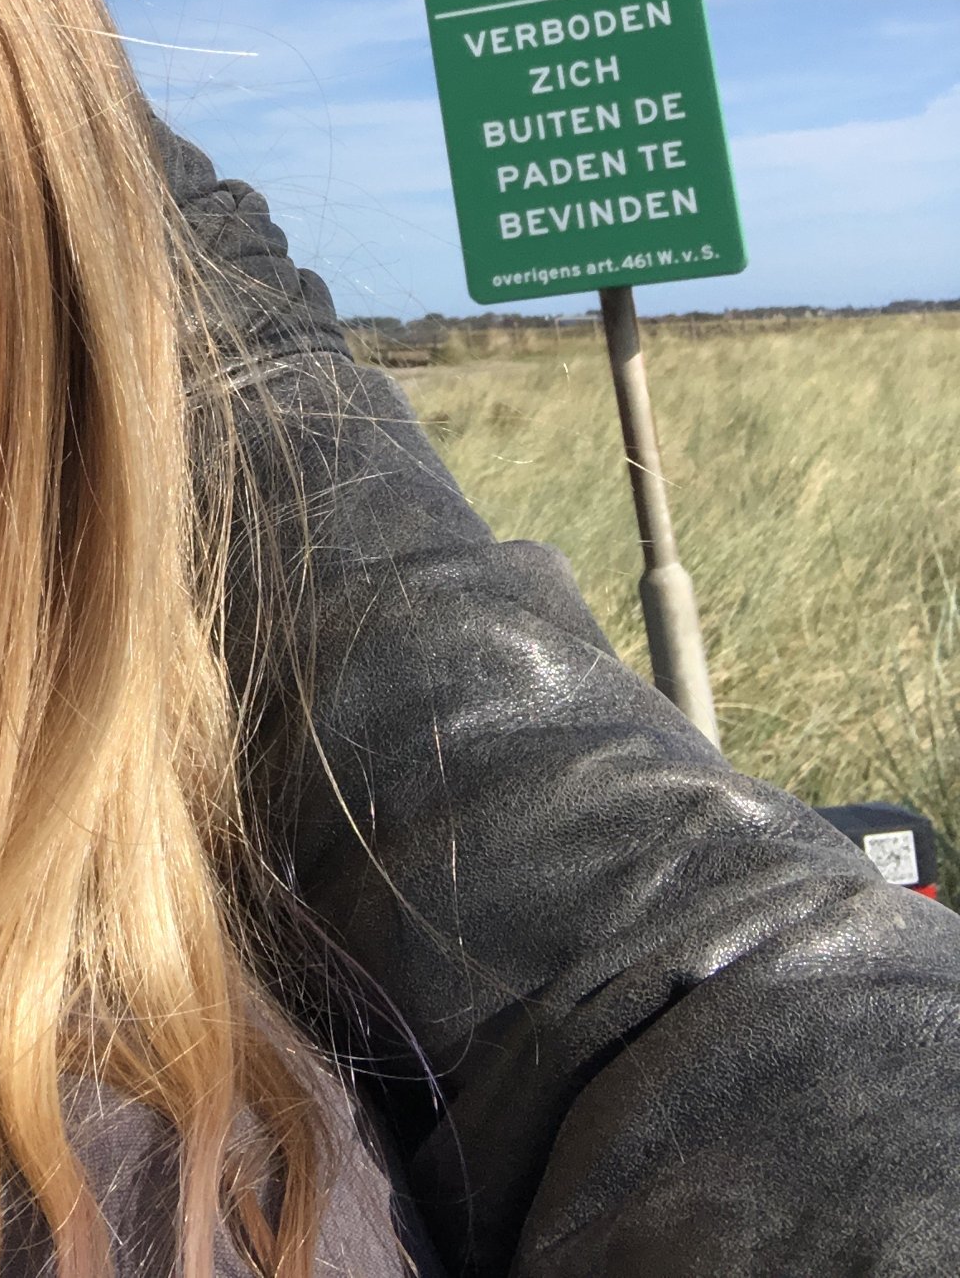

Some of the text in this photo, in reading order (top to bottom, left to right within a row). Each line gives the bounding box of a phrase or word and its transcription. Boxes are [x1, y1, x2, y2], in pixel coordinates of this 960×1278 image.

[463, 0, 672, 58] VERBODEN
[528, 55, 620, 95] ZICH
[482, 92, 686, 148] BUITEN DE
[497, 140, 686, 193] PADEN TE
[499, 186, 698, 240] BEVINDEN
[492, 265, 582, 287] overigens
